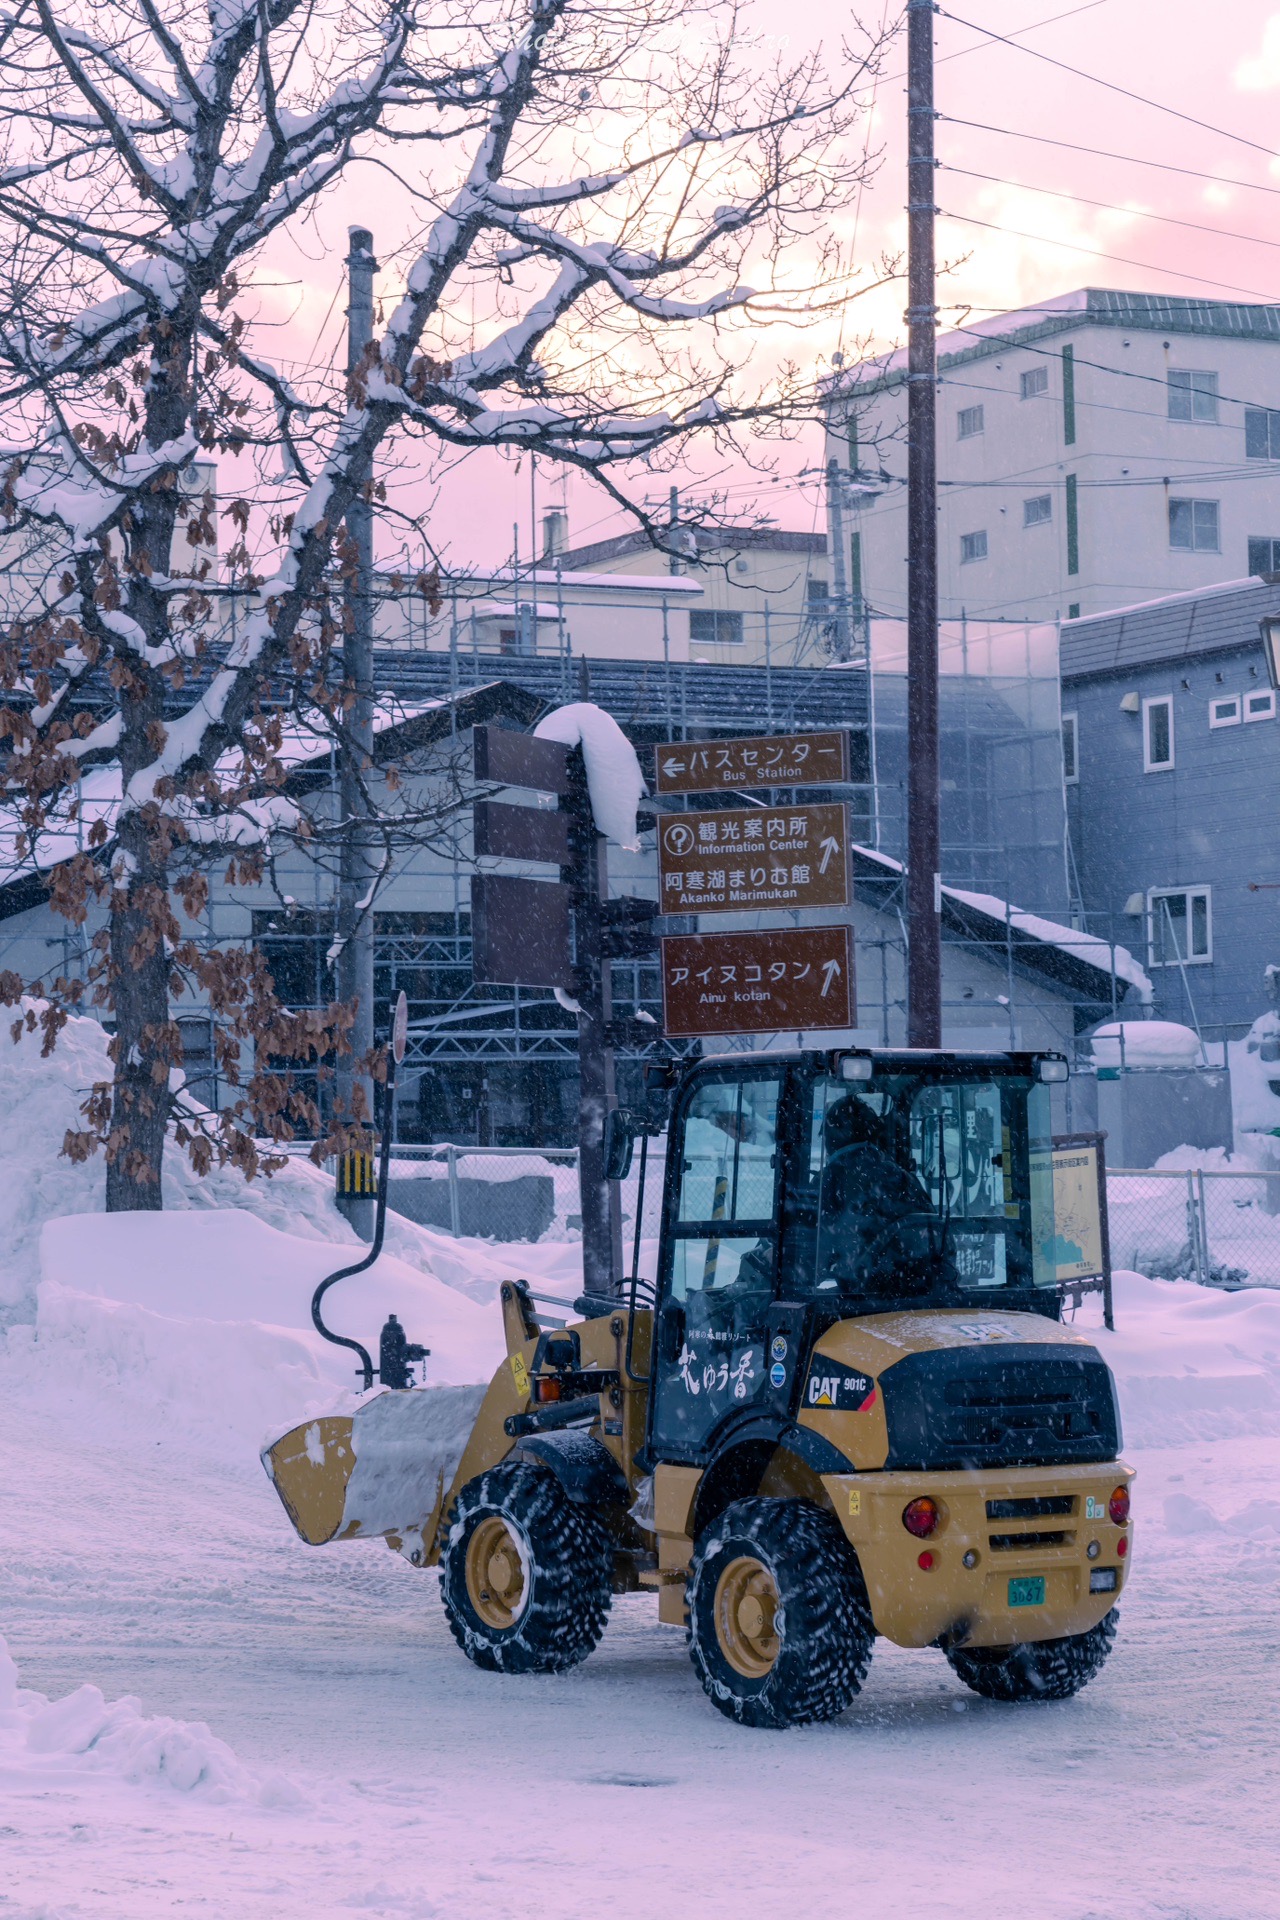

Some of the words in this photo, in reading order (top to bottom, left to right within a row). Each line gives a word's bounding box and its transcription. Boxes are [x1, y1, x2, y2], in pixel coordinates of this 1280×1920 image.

[690, 743, 835, 770] バスセンター
[723, 770, 746, 781] Bus
[757, 766, 802, 779] Station
[698, 816, 808, 841] 観光案内所
[699, 841, 765, 855] Information
[769, 839, 809, 851] Center
[665, 864, 811, 892] 阿寒湖まりむ館
[679, 892, 725, 904] Akanko
[729, 889, 797, 901] Marimukan
[670, 961, 811, 986] アイヌコタン
[699, 993, 726, 1004] Ainu
[734, 991, 771, 1002] kotan
[808, 1376, 841, 1405] CAT
[843, 1376, 867, 1392] 901C
